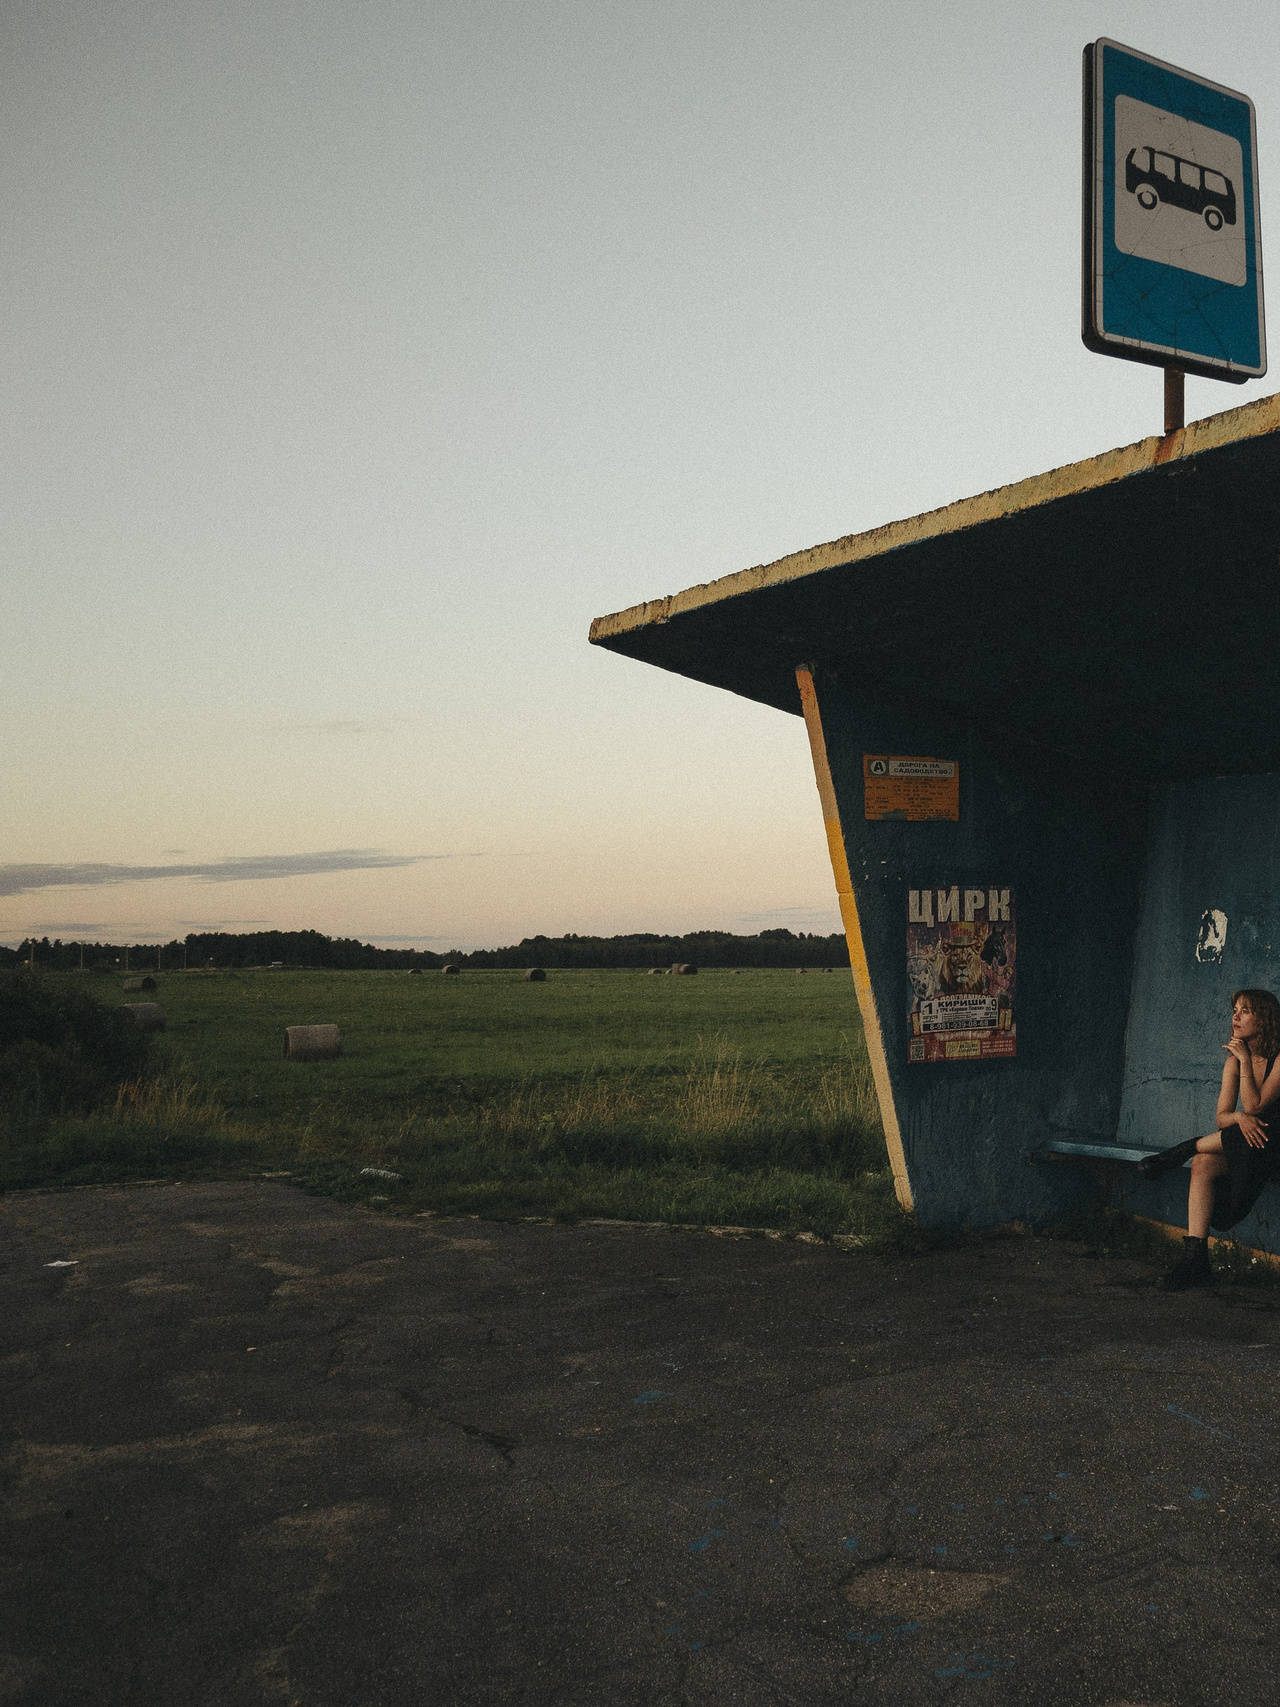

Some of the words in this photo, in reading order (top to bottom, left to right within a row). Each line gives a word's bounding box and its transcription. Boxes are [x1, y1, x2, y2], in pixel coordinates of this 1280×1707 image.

[908, 889, 1011, 928] ЦИРК
[924, 1002, 933, 1015] 1
[938, 998, 986, 1008] КИРИШИ
[991, 998, 997, 1011] 9
